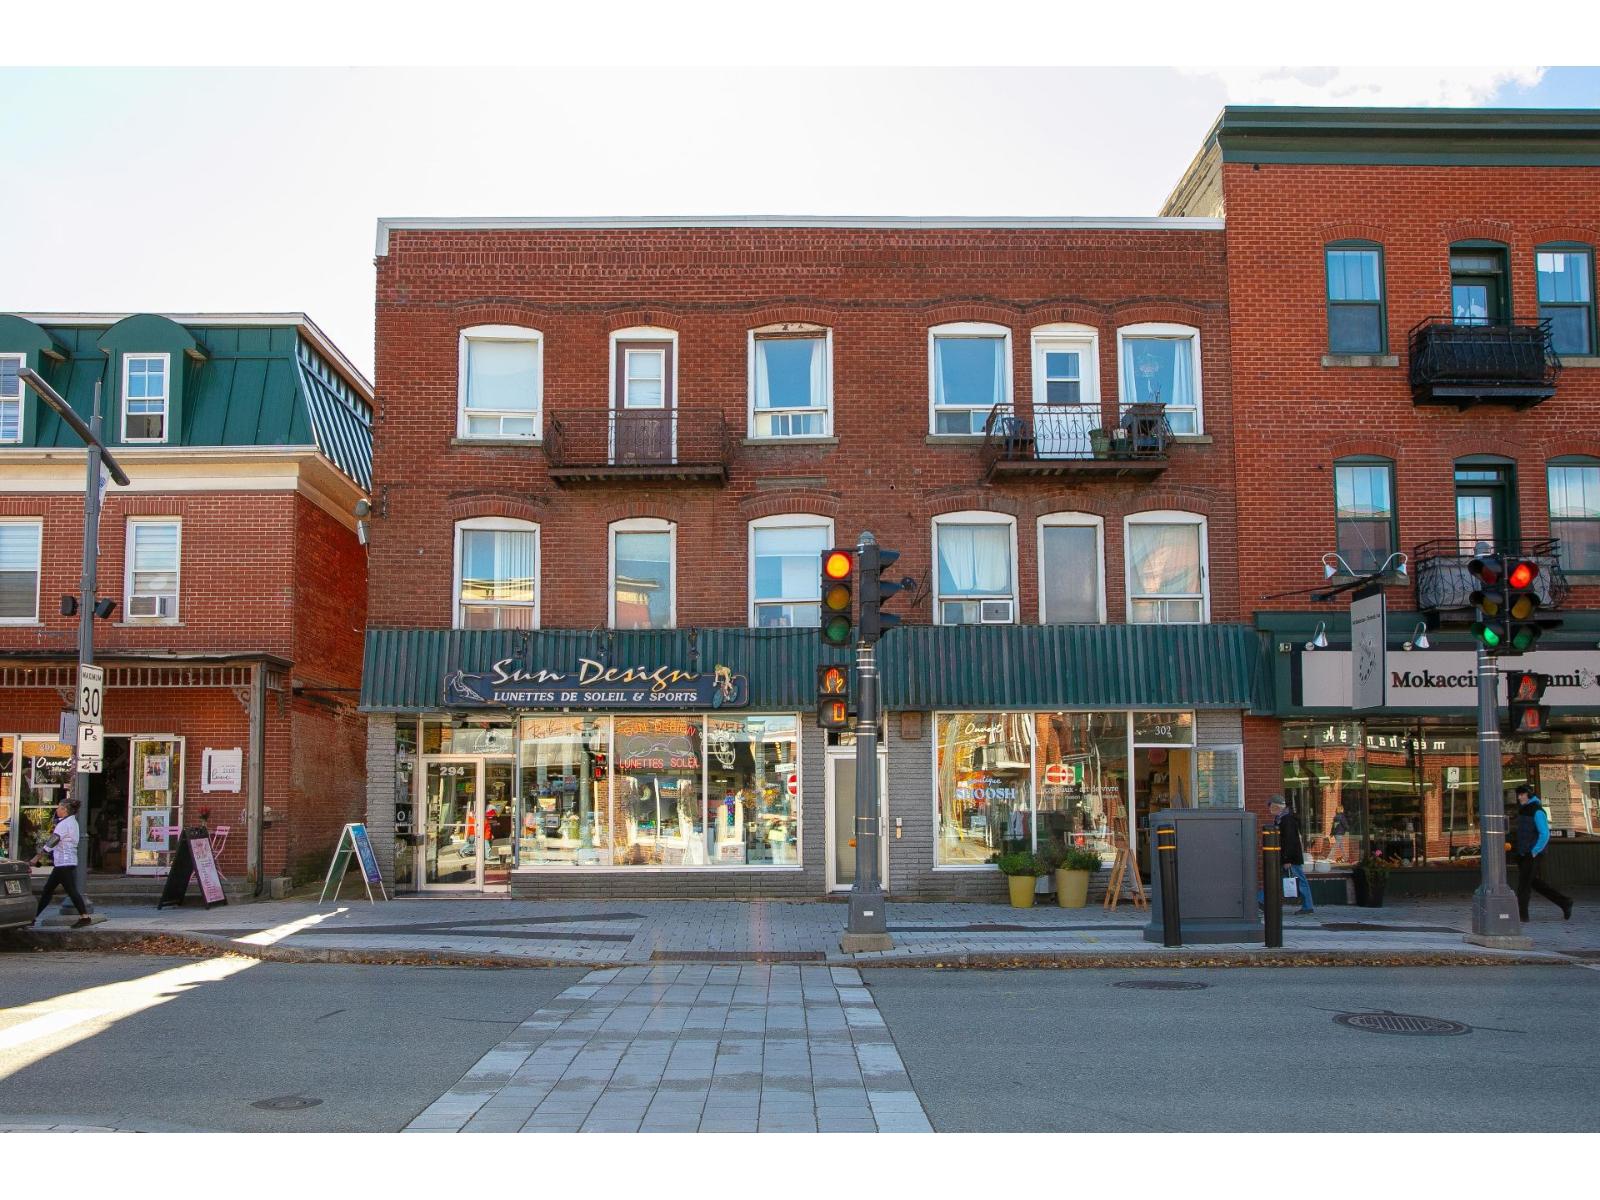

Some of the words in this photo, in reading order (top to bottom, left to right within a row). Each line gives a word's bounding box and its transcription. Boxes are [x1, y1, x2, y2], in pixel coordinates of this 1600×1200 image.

[82, 671, 102, 682] MAXIMUM
[491, 658, 566, 685] Sun
[578, 658, 699, 692] Design
[1391, 669, 1478, 688] Mokacci
[82, 686, 101, 718] 30
[493, 692, 555, 702] LUNETTES
[560, 692, 578, 702] DE
[583, 692, 627, 702] SOLEIL
[632, 692, 645, 702] &
[649, 692, 698, 702] SPORTS
[964, 722, 1004, 734] Ouvert
[1155, 725, 1171, 737] 302
[36, 756, 73, 769] Ouvert
[439, 766, 465, 776] 294
